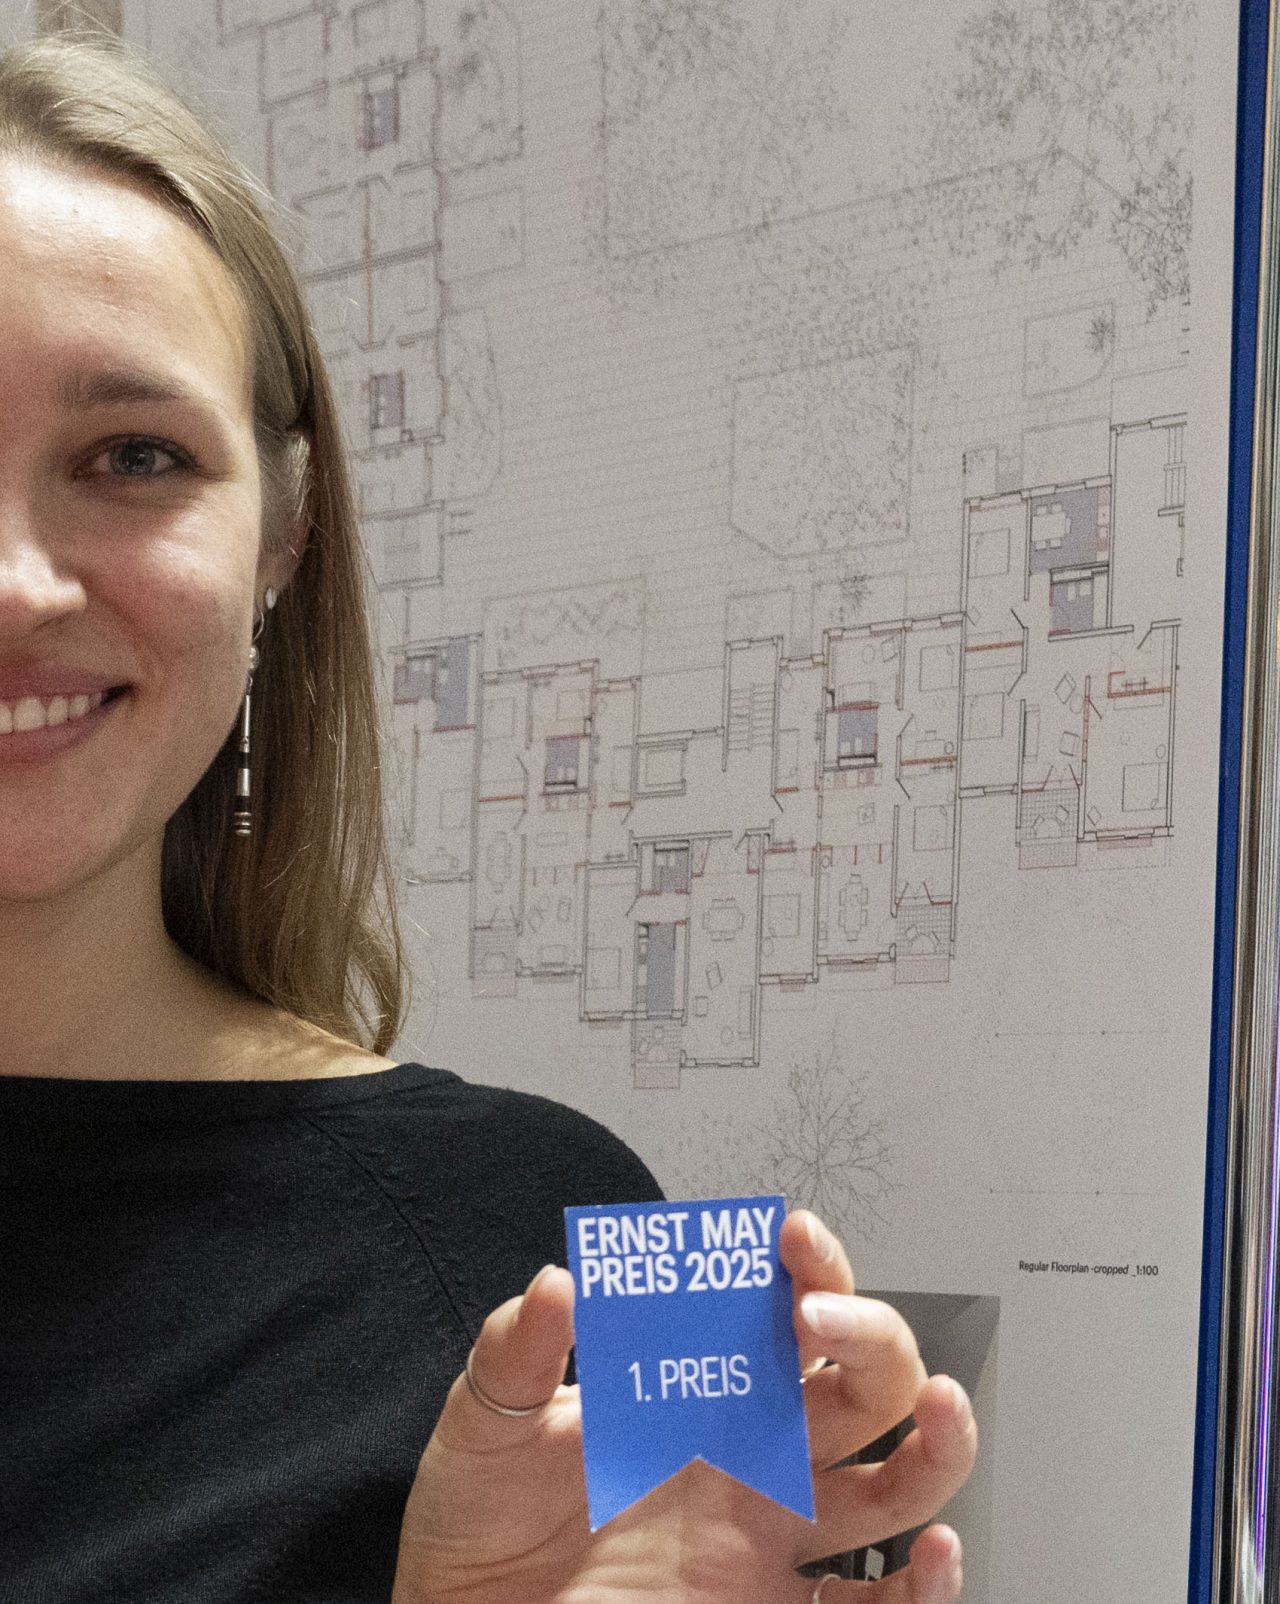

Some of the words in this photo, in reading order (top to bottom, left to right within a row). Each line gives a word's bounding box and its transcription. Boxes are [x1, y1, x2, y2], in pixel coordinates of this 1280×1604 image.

[576, 1211, 690, 1258] ERNST
[700, 1206, 775, 1250] MAY
[580, 1253, 680, 1298] PREIS
[685, 1247, 773, 1292] 2025
[1019, 1260, 1050, 1274] Regular
[1051, 1261, 1090, 1274] Floorplan
[628, 1361, 653, 1402] 1.
[659, 1354, 753, 1400] PREIS
